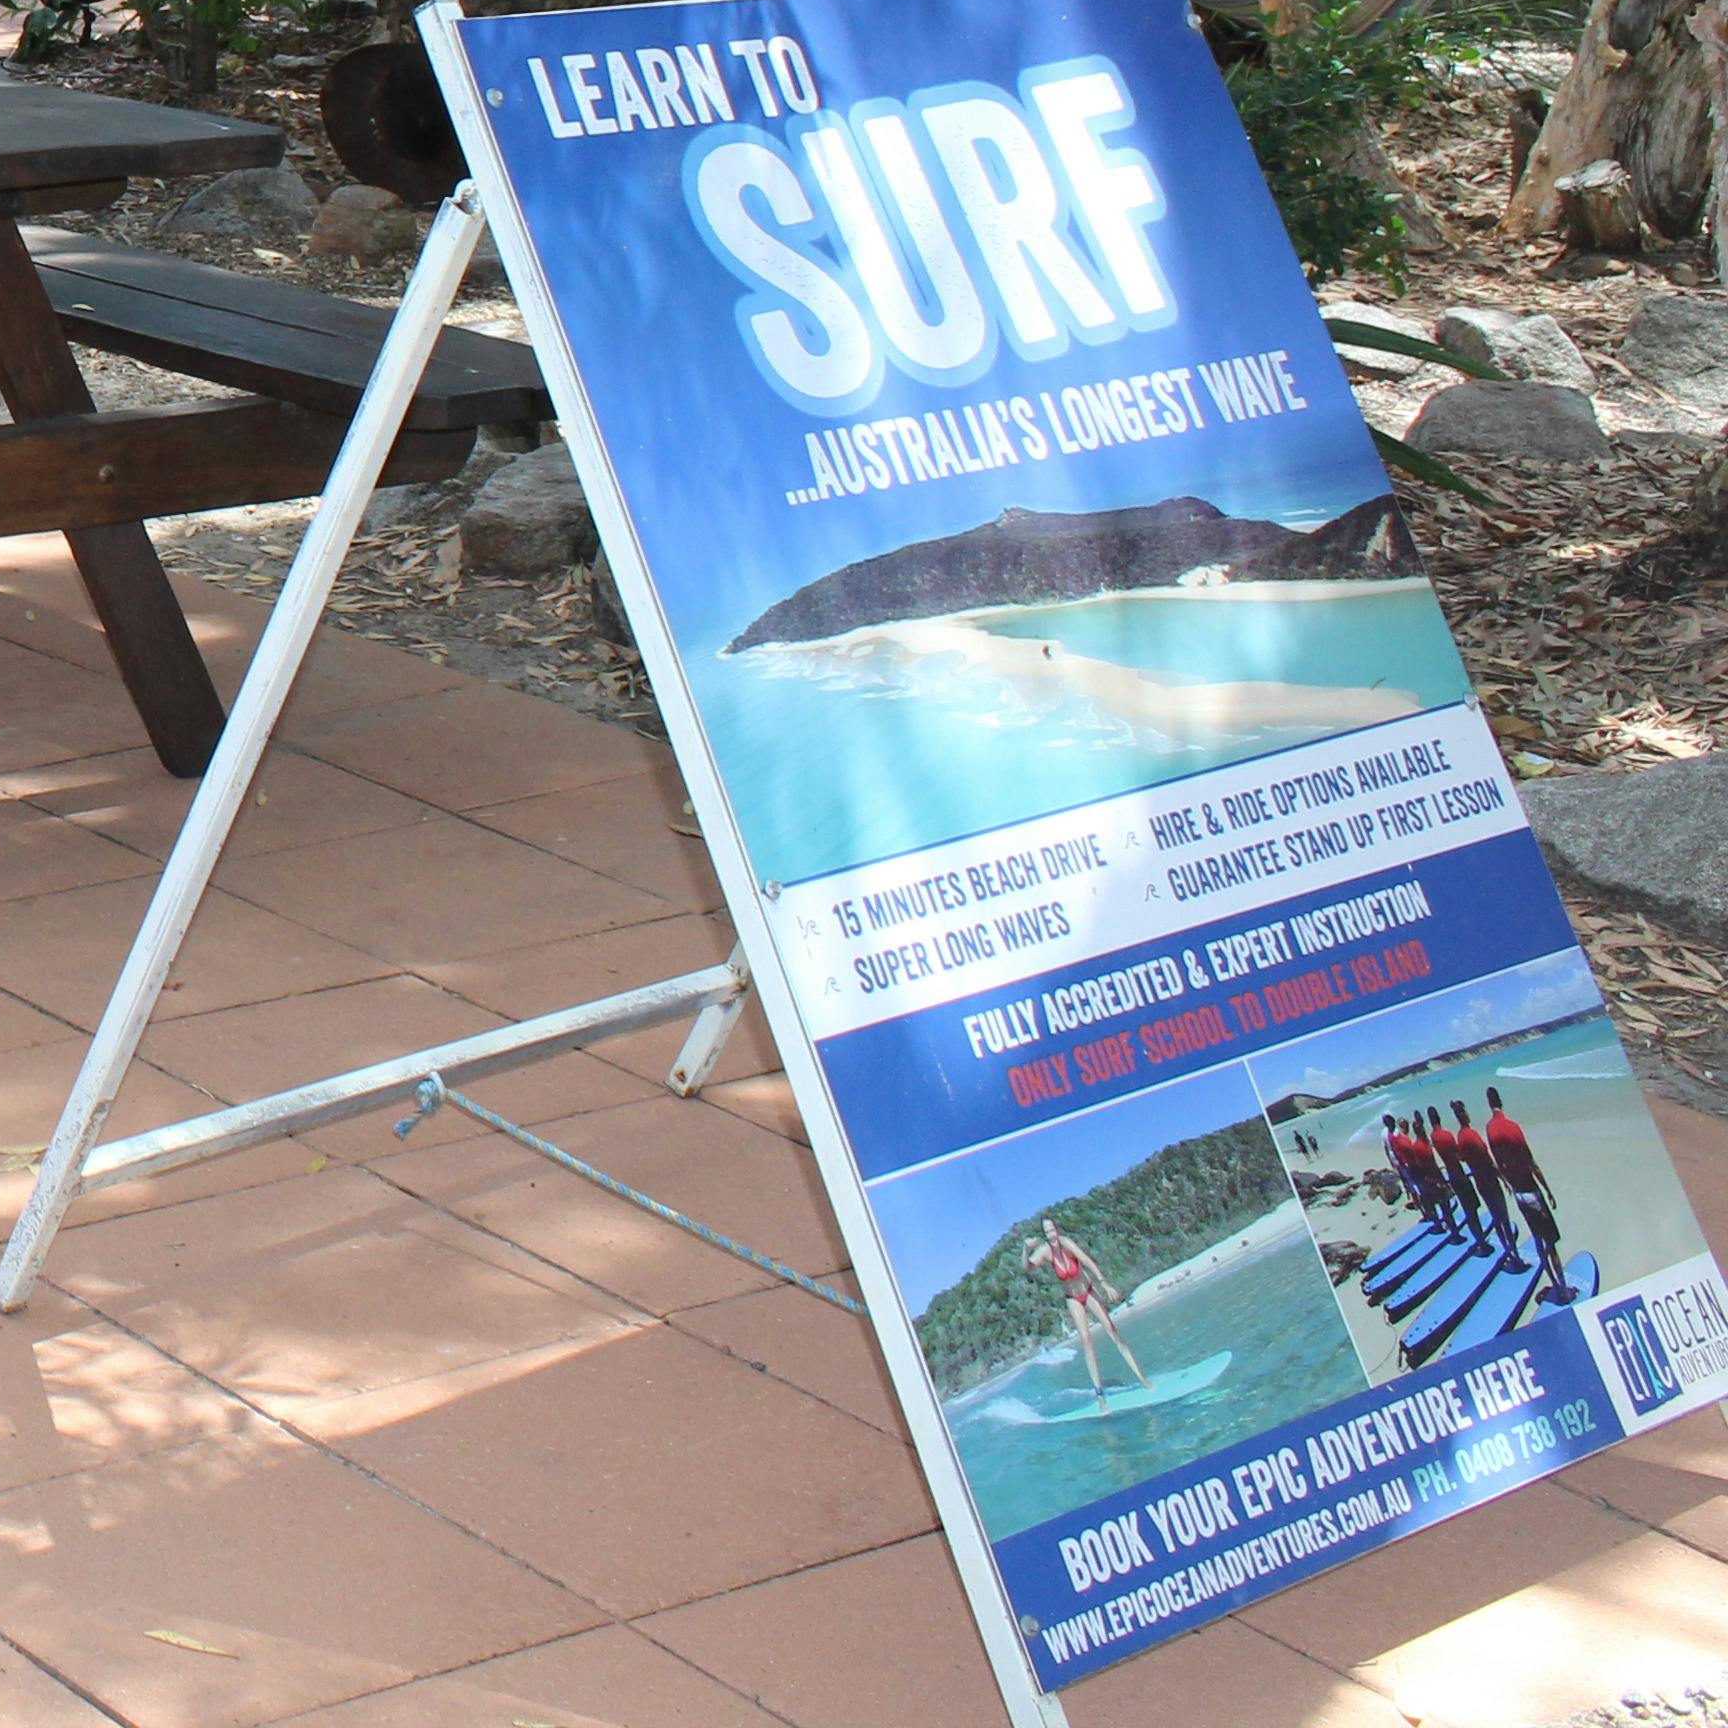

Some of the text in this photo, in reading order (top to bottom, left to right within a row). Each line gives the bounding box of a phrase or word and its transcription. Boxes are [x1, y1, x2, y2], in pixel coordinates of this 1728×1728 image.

[527, 36, 820, 139] LEARN TO
[696, 71, 1167, 400] SURF
[1040, 368, 1205, 454] LONGEST
[1198, 350, 1307, 424] WAVE
[1149, 739, 1452, 851] HIRE & RIDE OPTIONS AVAILABLE
[1167, 776, 1506, 903] GUARANTEE STAND UP FIRST LESSON
[832, 834, 1108, 939] 15 MINUTES BEACH DRIVE
[853, 901, 1072, 994] SUPER LONG WAVES
[962, 879, 1432, 1059] FULLY ACCREDITED & EXPERT INSTRUCTION
[1007, 939, 1431, 1109] ONLY SURF SCHOOL TO DOUBLE ISLAND
[1651, 1277, 1728, 1353] OCEAN
[1058, 1348, 1546, 1594] BOOK YOUR EPIC ADVENTURE HERE
[1042, 1399, 1597, 1665] WWW.EPICOCEANADVENTURES.COM.AU PH. 0408 738 192
